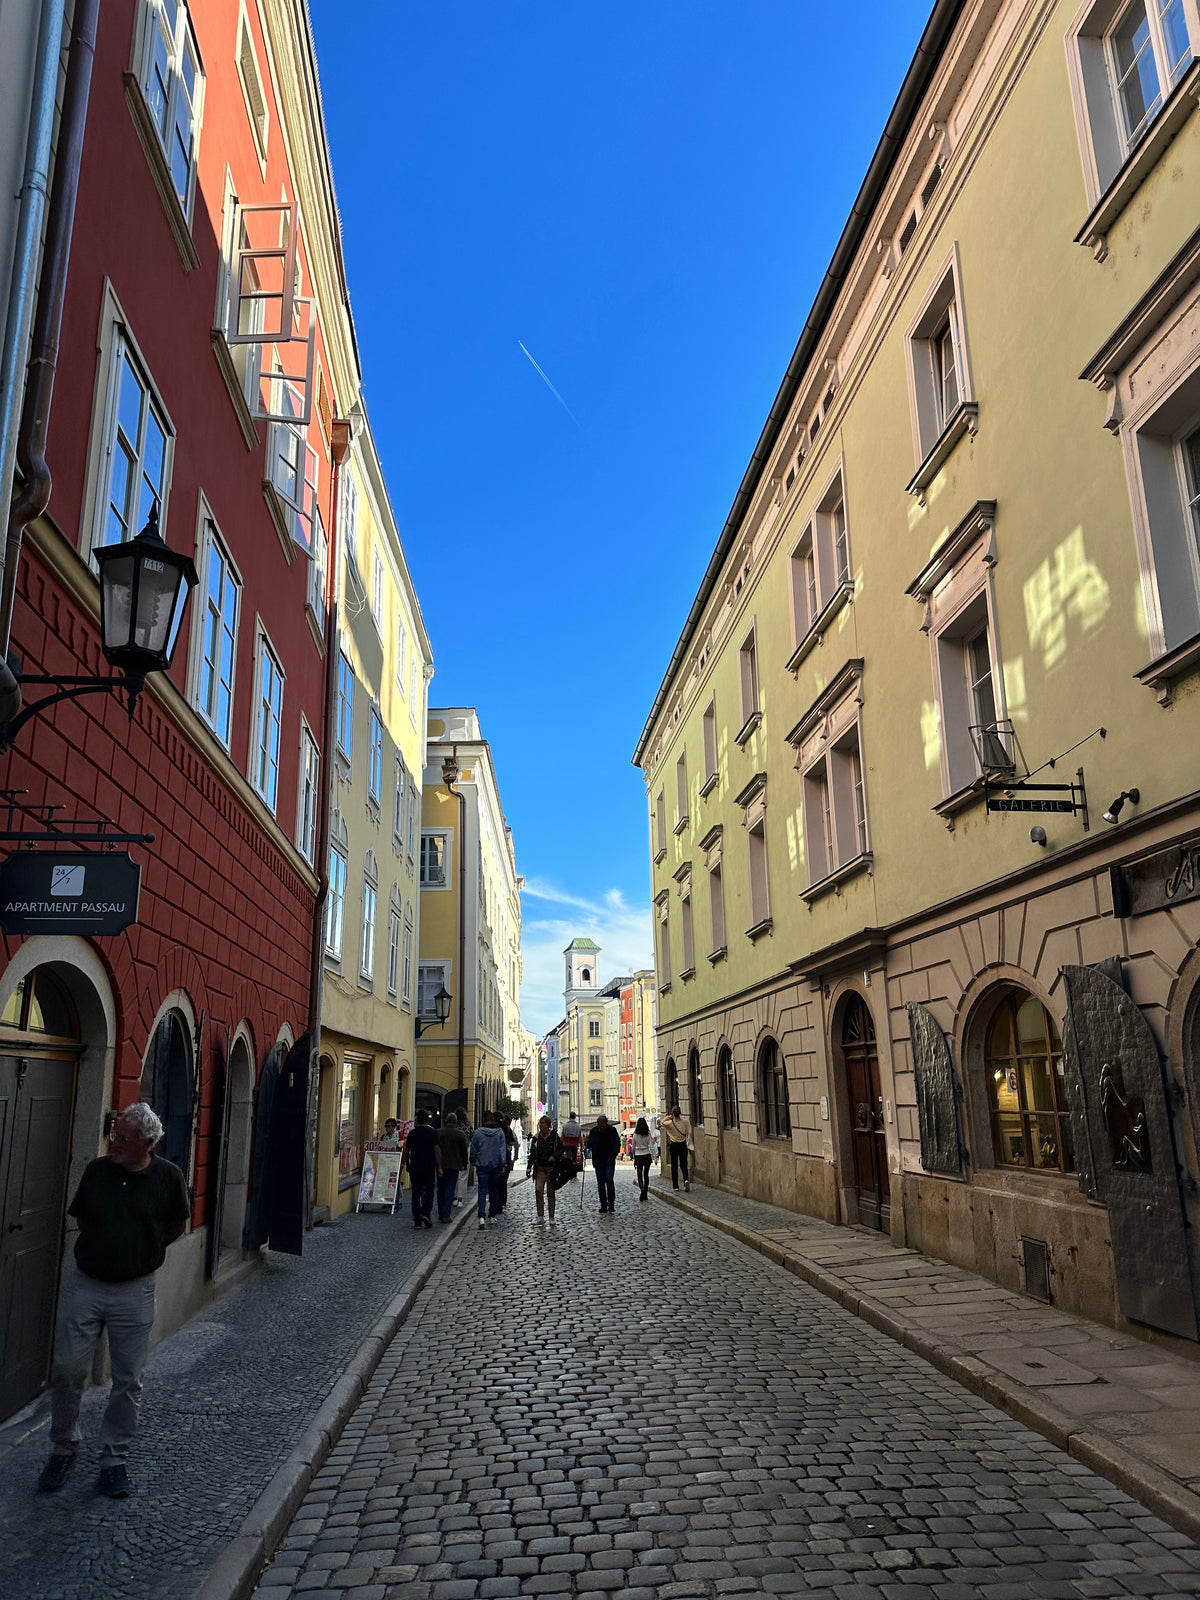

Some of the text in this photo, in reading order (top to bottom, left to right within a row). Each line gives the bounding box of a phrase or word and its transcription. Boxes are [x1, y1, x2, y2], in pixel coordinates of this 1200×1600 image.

[998, 799, 1065, 812] GALERIE
[5, 902, 126, 913] APARTMENT PASSAU
